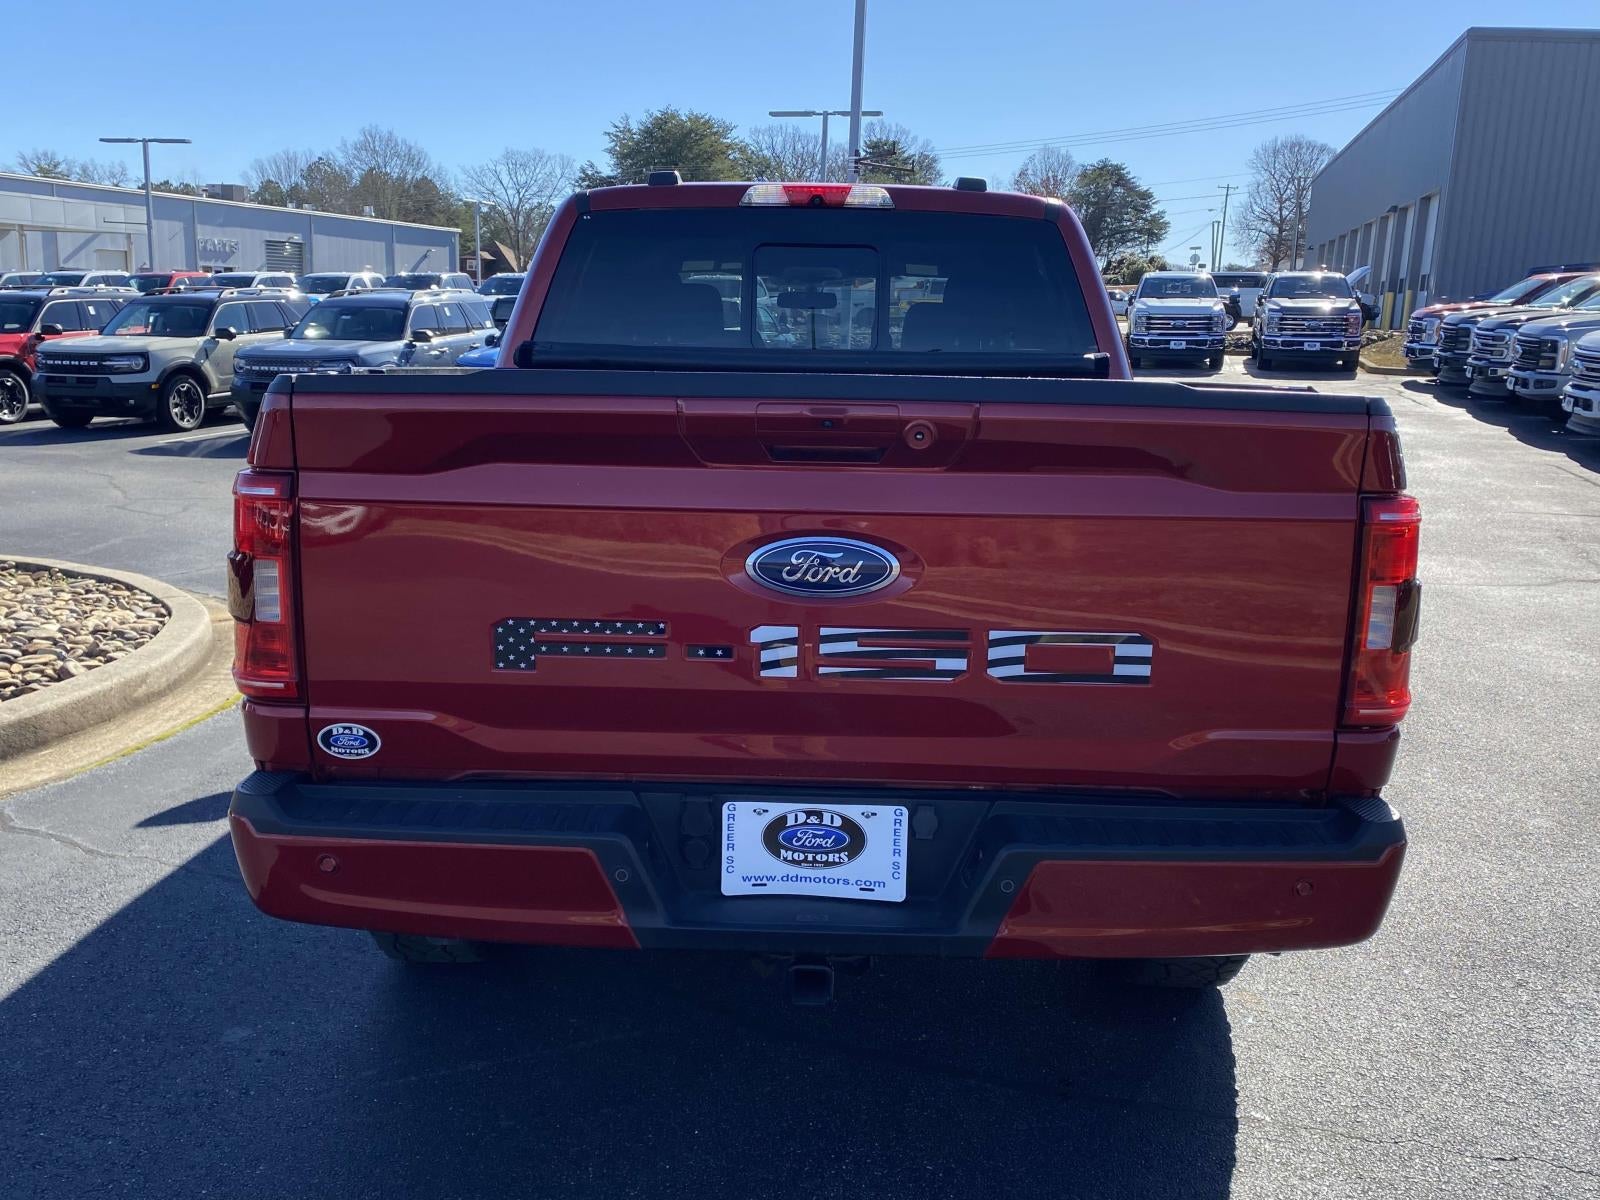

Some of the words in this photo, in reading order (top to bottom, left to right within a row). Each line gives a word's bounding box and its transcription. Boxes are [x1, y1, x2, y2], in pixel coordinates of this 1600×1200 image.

[198, 238, 239, 253] PARTS
[47, 359, 97, 367] BRONCO
[782, 549, 864, 585] Ford
[491, 618, 1154, 685] F-150
[332, 727, 364, 735] D&D
[337, 737, 361, 745] Ford
[331, 746, 369, 754] MOTORS
[727, 803, 736, 851] GREER
[785, 811, 843, 827] D&D
[792, 830, 835, 847] Ford
[893, 808, 903, 857] GREER
[780, 849, 849, 863] MOTORS
[727, 856, 735, 874] SC
[891, 861, 901, 881] SC
[742, 873, 886, 888] www.ddmotors.com
